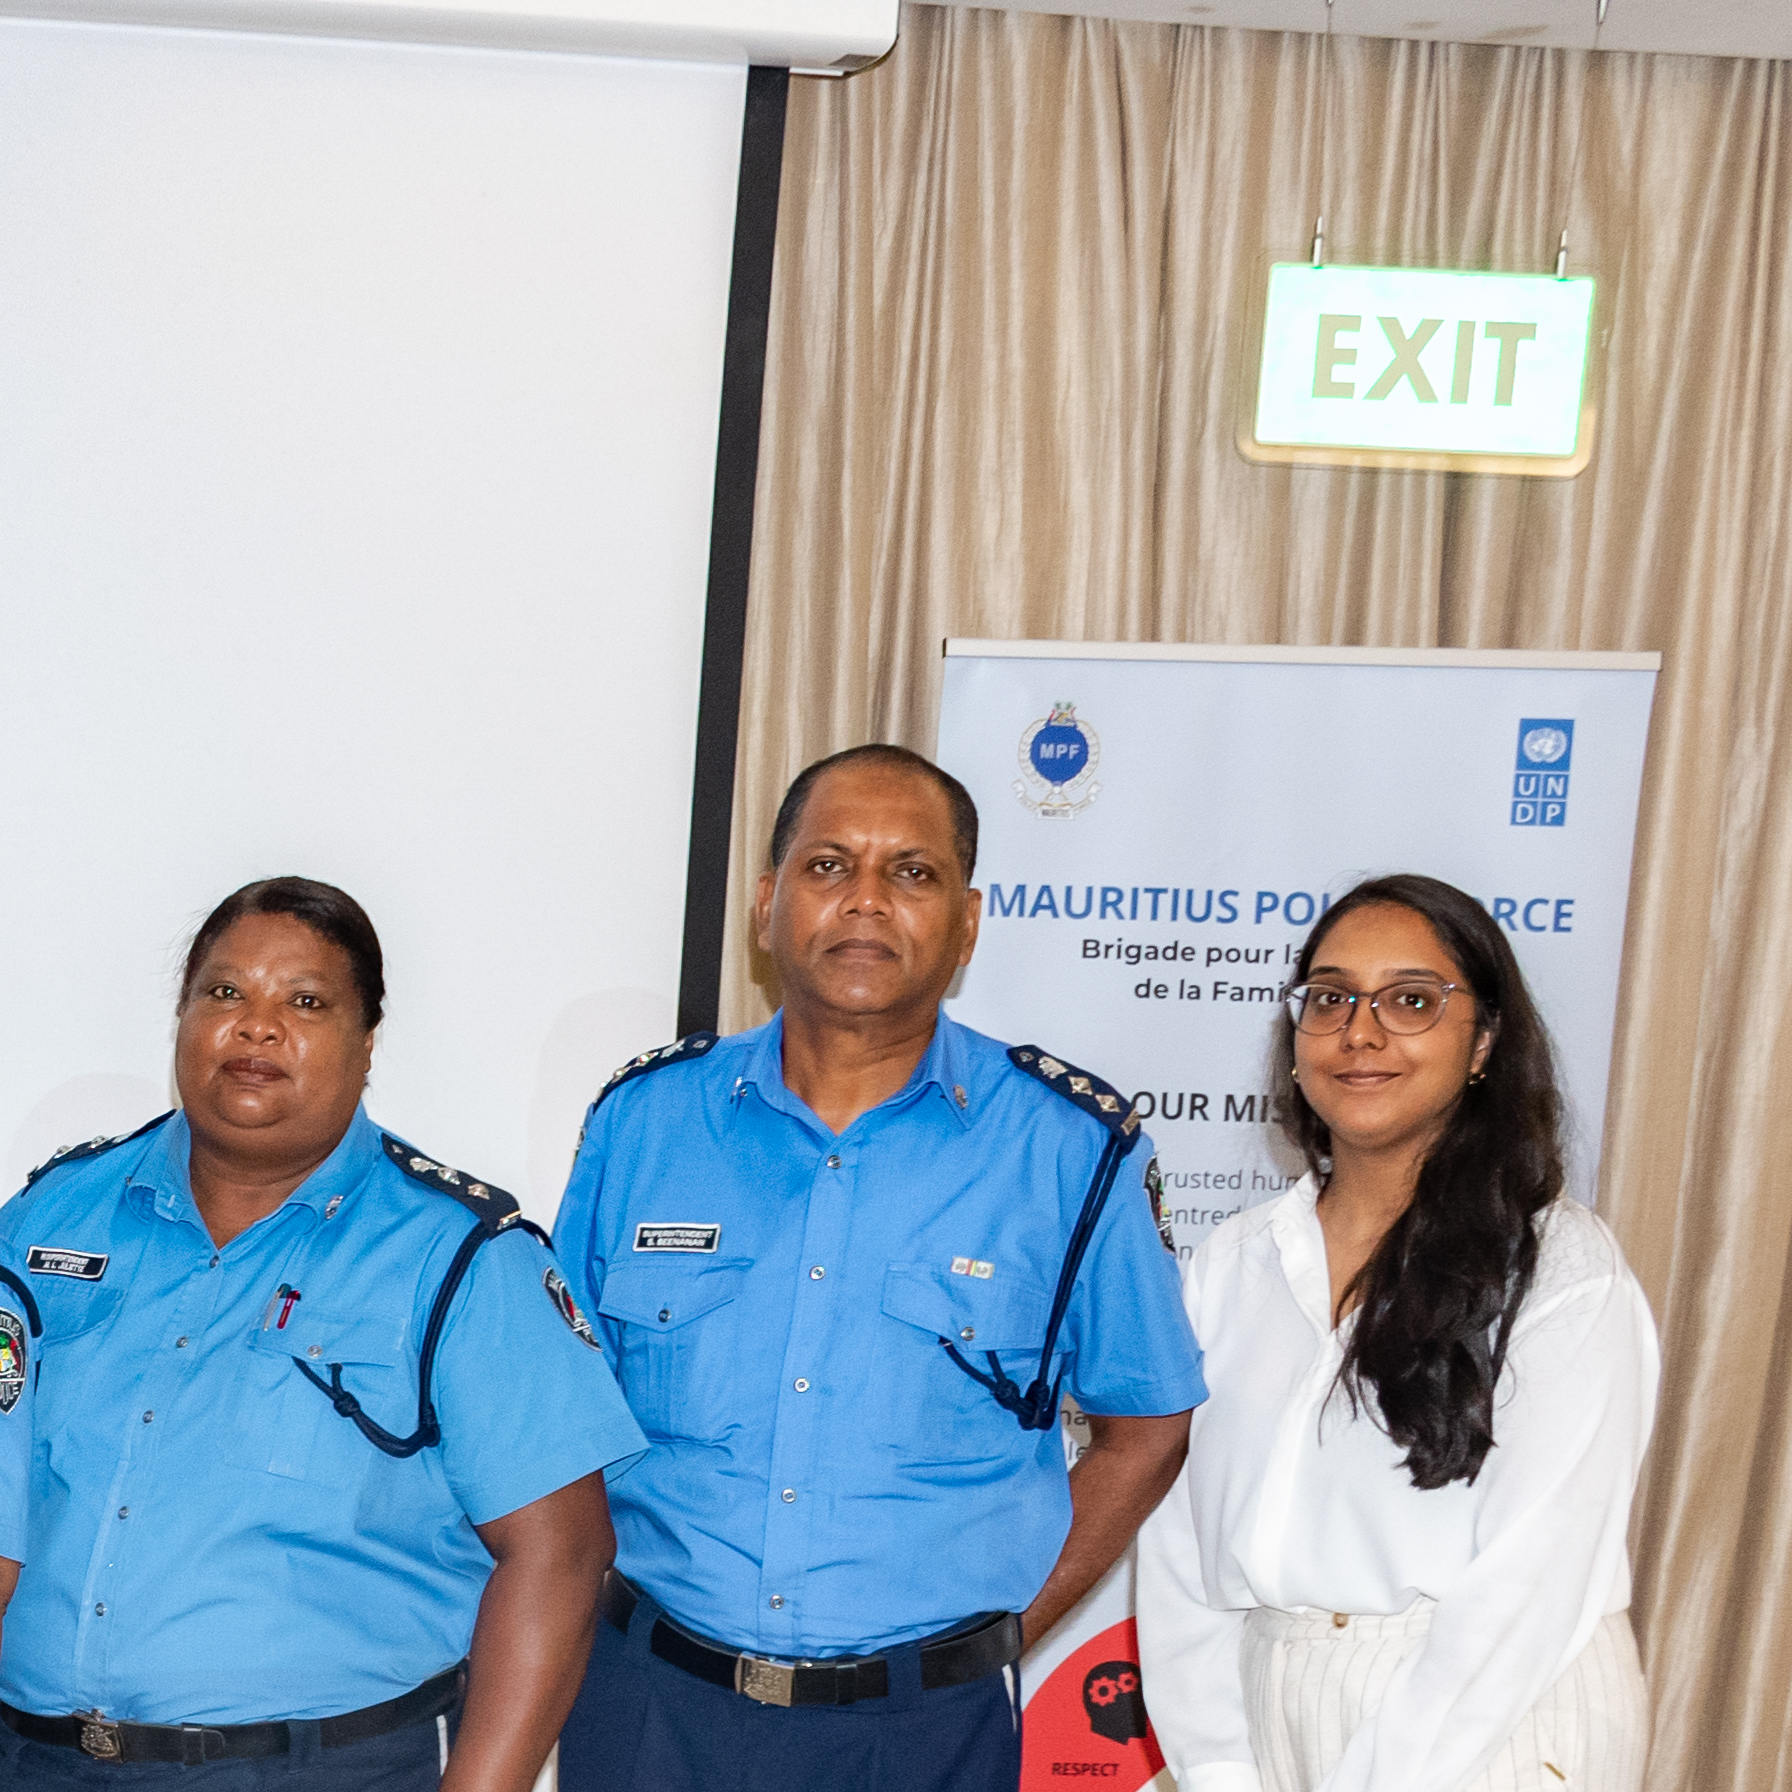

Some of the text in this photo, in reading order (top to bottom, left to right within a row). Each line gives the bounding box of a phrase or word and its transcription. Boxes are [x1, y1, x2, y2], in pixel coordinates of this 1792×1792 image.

[1312, 313, 1537, 407] EXIT
[1039, 742, 1081, 760] MPF
[987, 883, 1240, 924] MAURITIUS
[1476, 896, 1575, 933] RCE
[1081, 938, 1196, 965] Brigade
[1205, 945, 1276, 967] pour
[1134, 977, 1288, 1003] de la Fami
[1131, 1091, 1210, 1121] OUR
[1163, 1168, 1243, 1190] rusted
[1051, 1762, 1120, 1777] RESPECT
